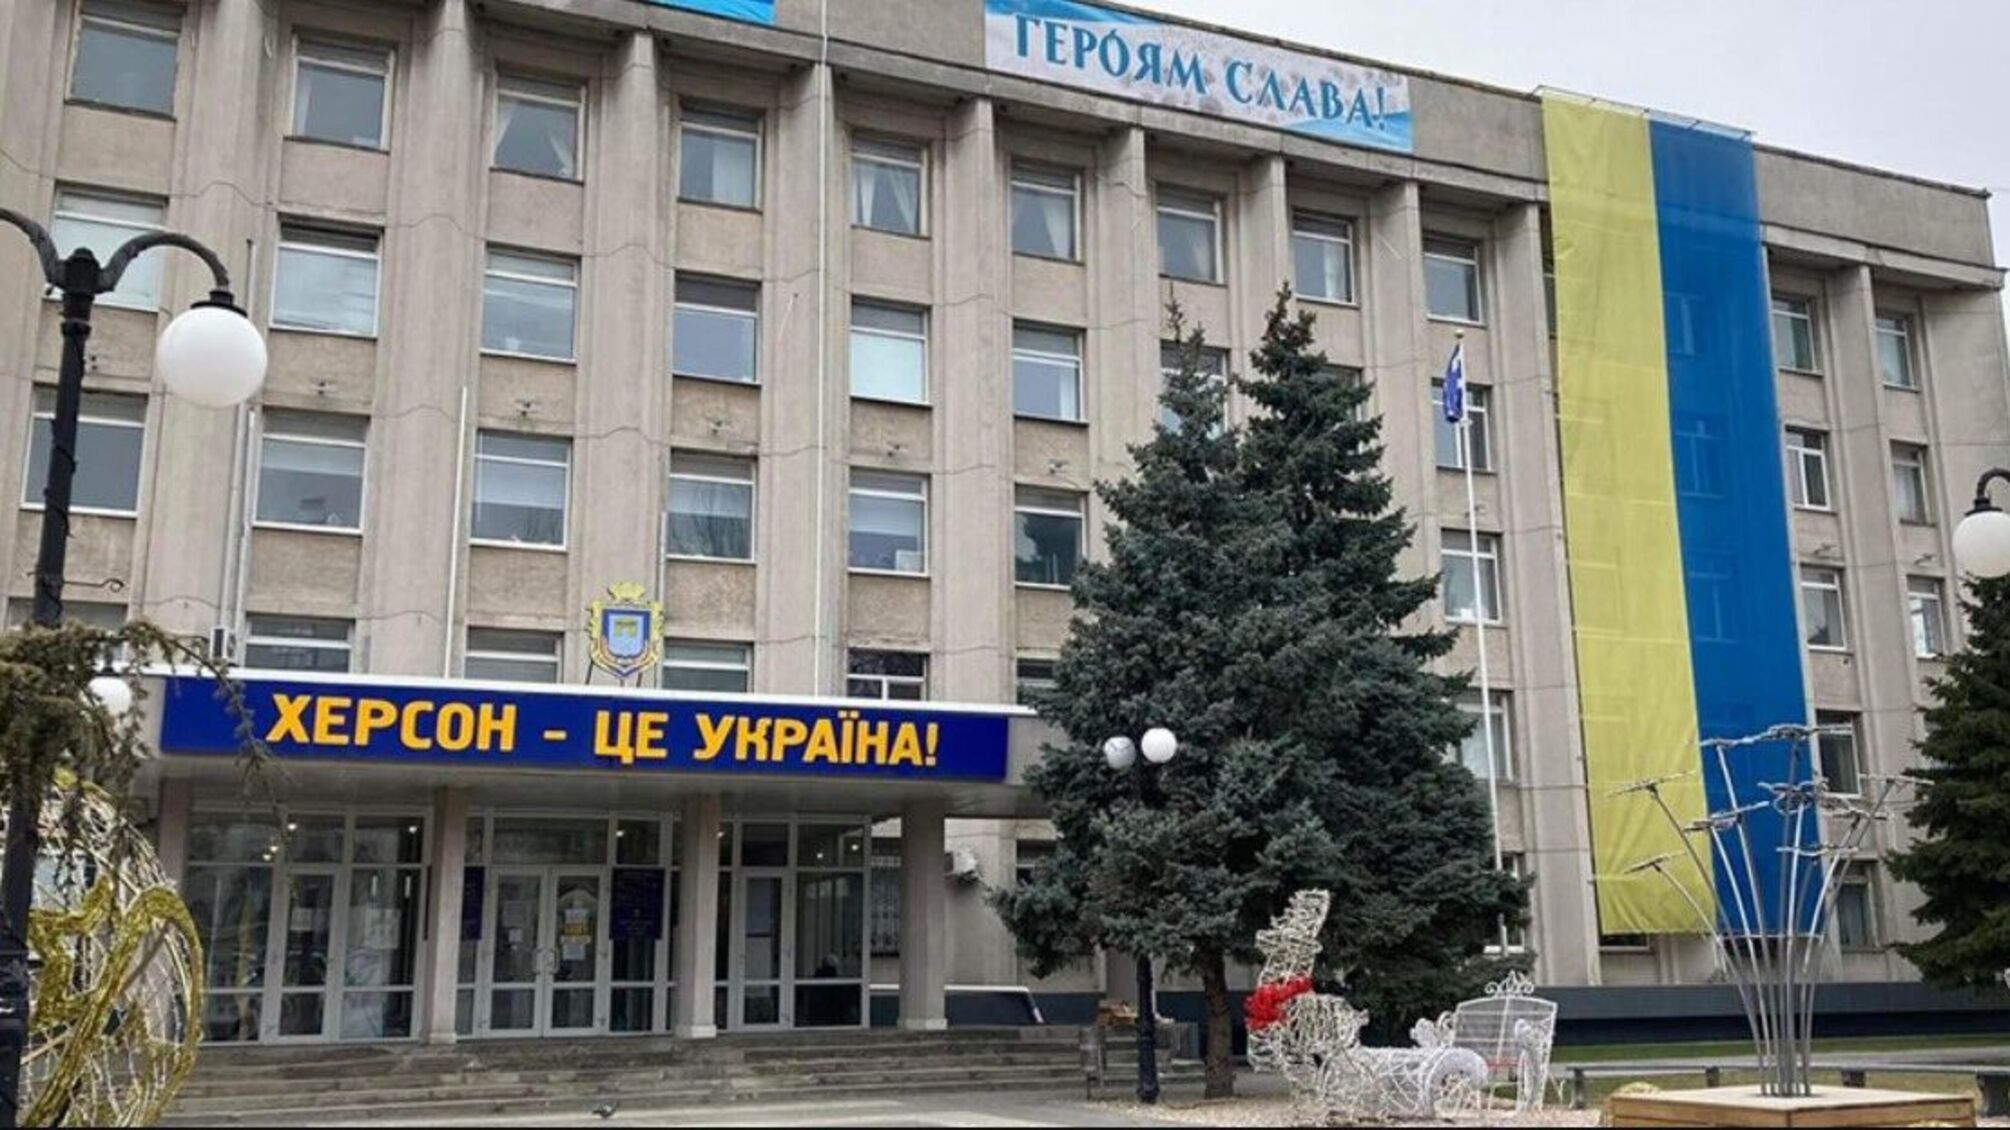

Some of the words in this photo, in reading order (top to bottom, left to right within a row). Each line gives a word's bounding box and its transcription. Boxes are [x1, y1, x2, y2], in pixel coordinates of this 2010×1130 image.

[1225, 60, 1385, 131] СЛАВА!
[266, 692, 517, 752] ХЕРСОН
[543, 729, 567, 741] -
[594, 710, 668, 764] ЦЕ
[693, 710, 939, 766] УКРАЇНА!
